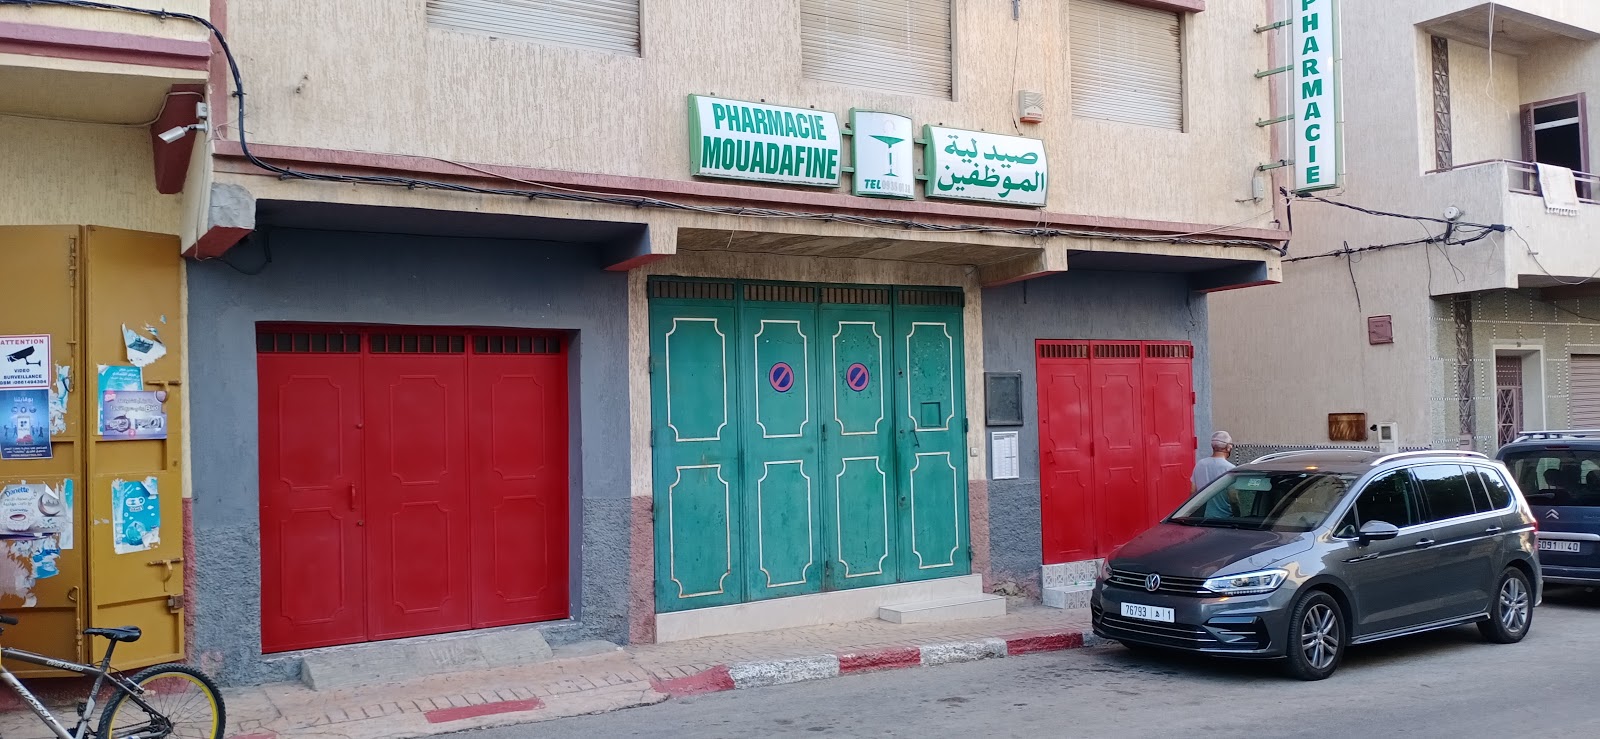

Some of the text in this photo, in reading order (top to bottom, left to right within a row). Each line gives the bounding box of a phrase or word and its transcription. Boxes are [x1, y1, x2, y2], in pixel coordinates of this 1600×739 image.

[712, 103, 827, 141] PHARMACIE
[702, 135, 838, 180] MOUADAFINE
[944, 134, 1039, 169] صيدلية
[864, 179, 881, 189] TEL
[937, 164, 1045, 198] الموظفين
[4, 486, 30, 497] Danette
[1568, 542, 1579, 551] 40
[1126, 605, 1147, 618] 76793
